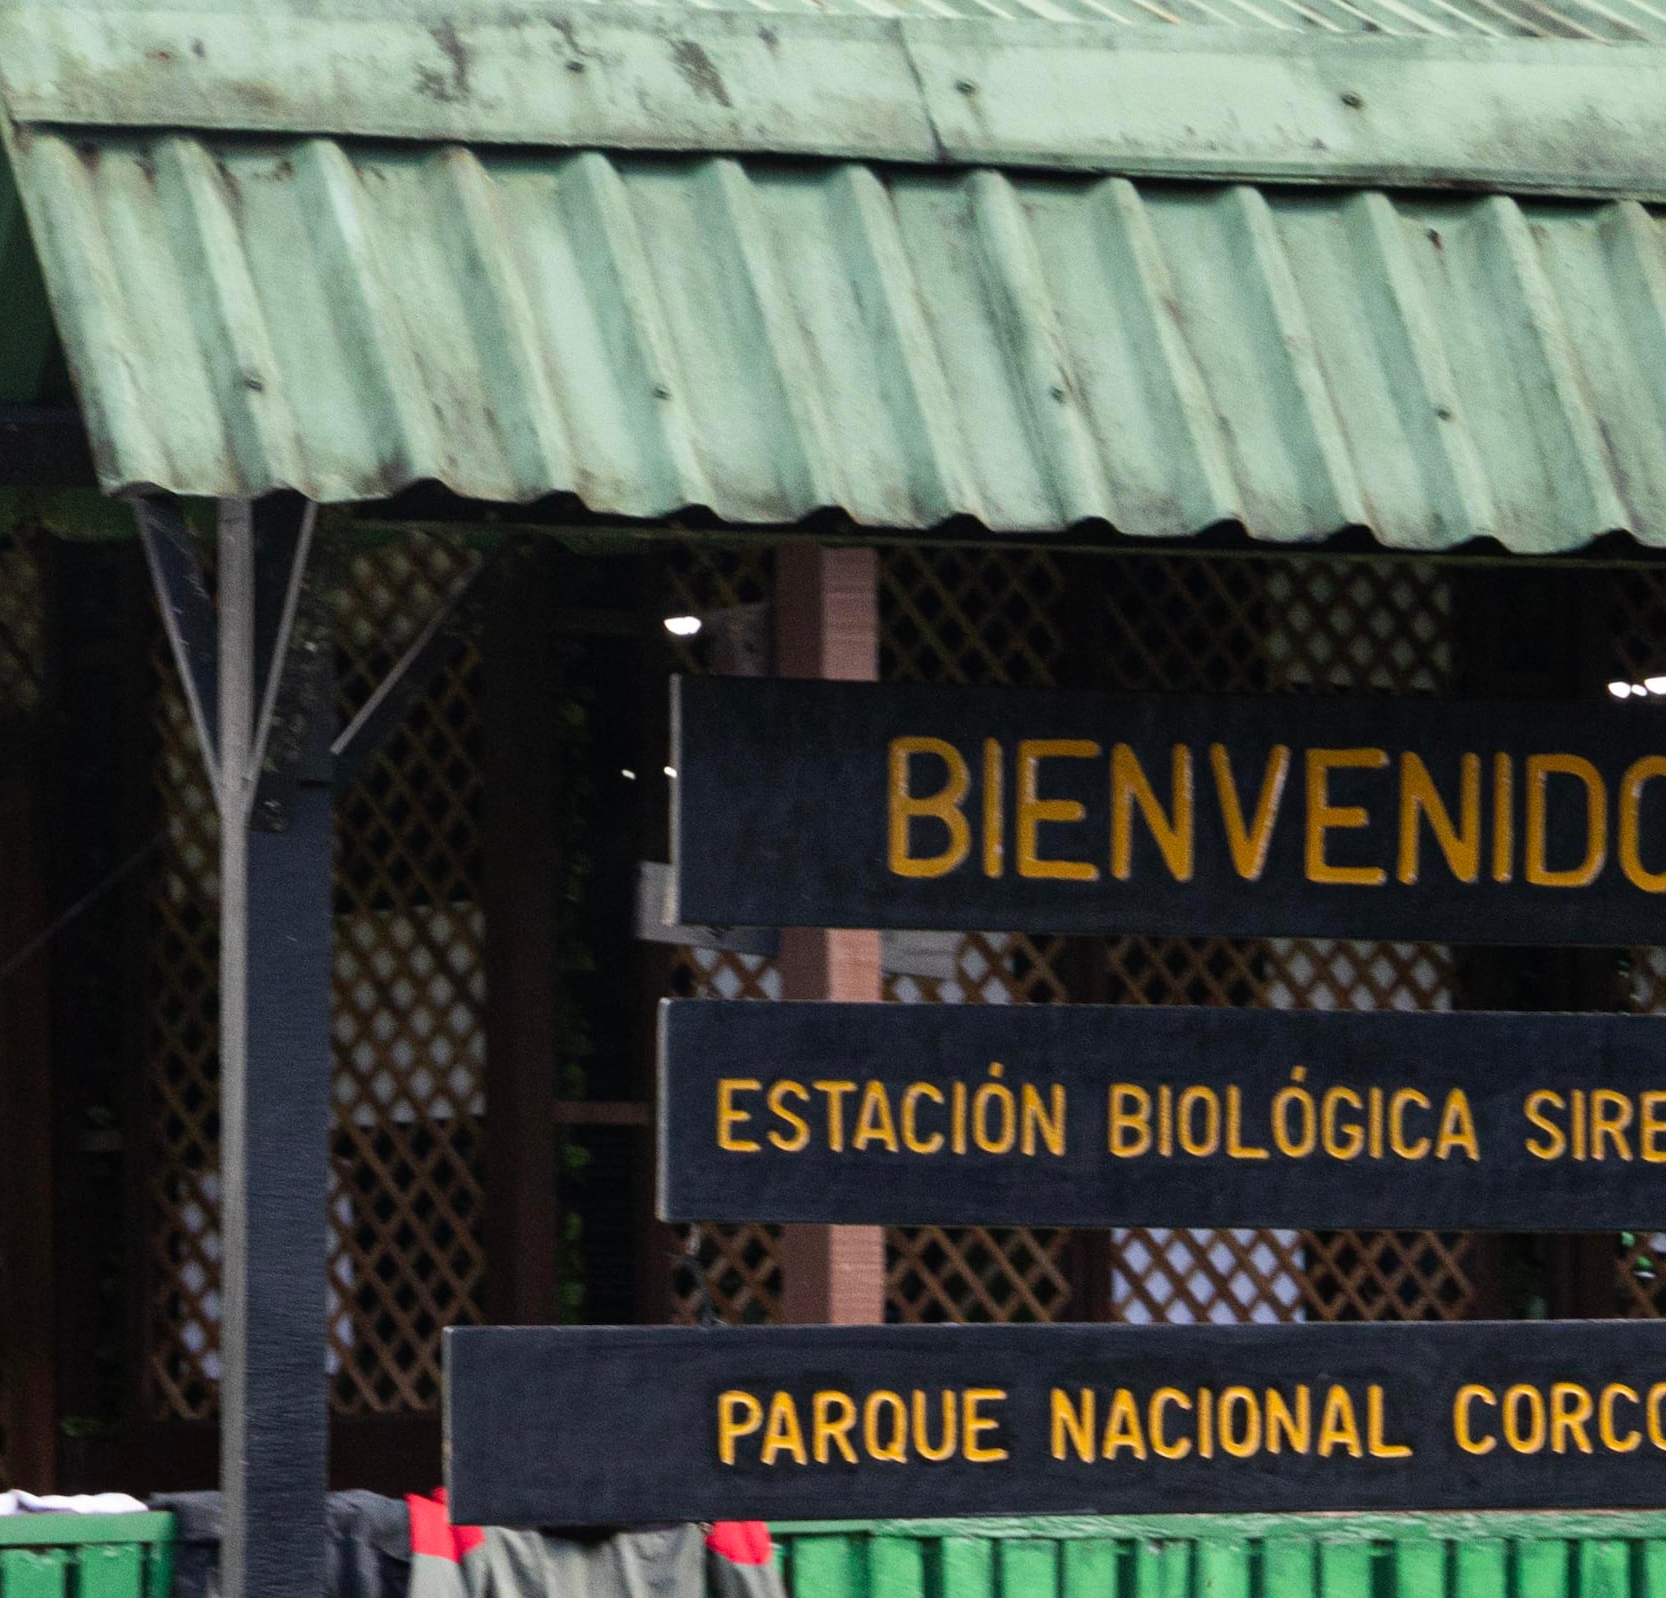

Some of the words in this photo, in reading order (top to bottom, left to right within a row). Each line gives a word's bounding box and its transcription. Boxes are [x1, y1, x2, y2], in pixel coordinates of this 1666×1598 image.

[717, 1062, 1066, 1156] ESTACIÓN
[1108, 1066, 1479, 1162] BIOLÓGICA
[717, 1388, 1008, 1463] PARQUE
[1050, 1384, 1412, 1461] NACIONAL
